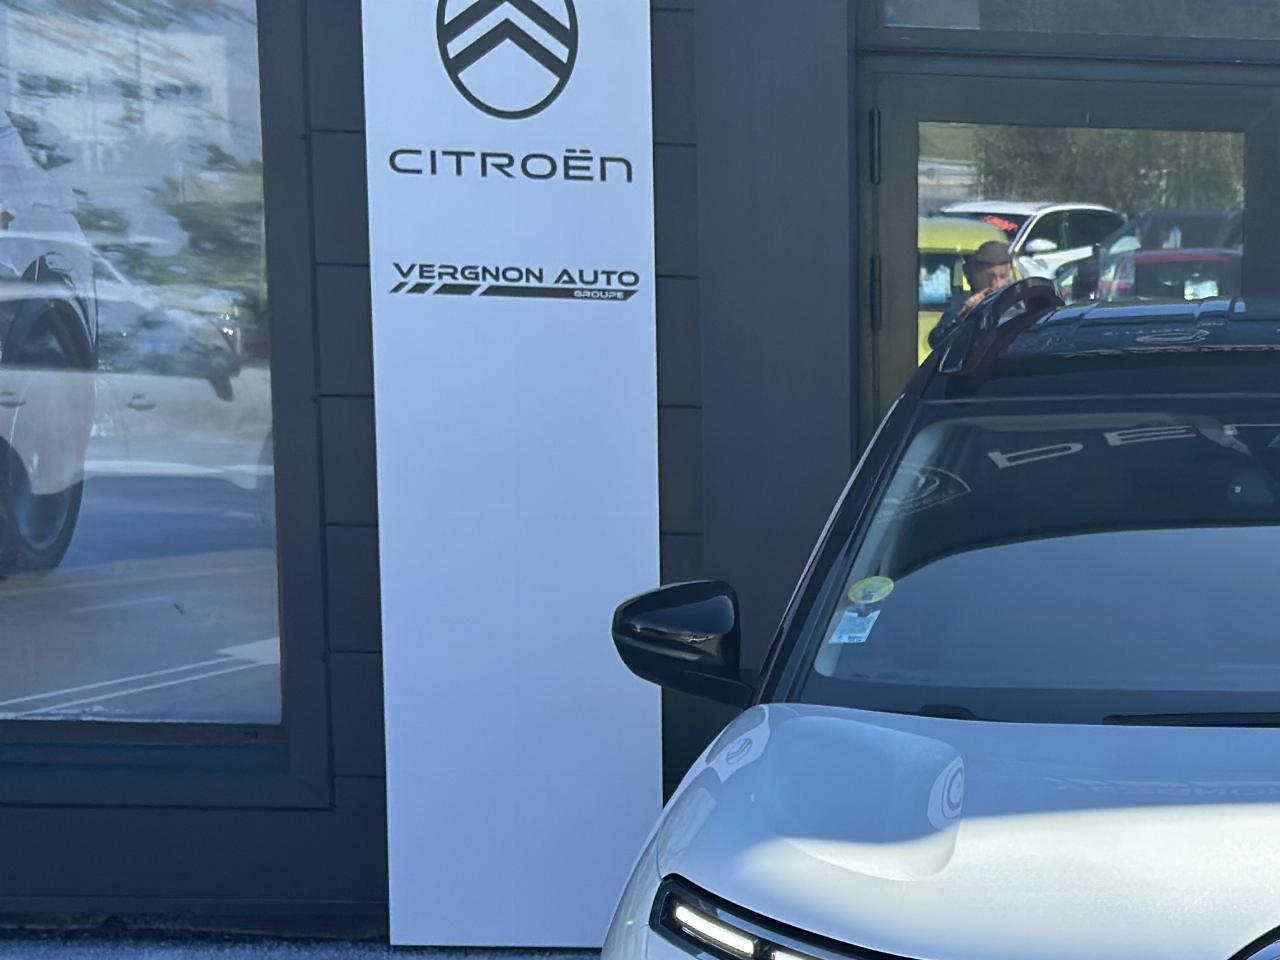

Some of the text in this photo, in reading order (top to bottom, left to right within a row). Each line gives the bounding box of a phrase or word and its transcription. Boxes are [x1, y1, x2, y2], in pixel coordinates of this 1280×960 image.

[388, 148, 633, 183] CITROËN
[392, 262, 640, 287] VERGNON AUTO
[574, 290, 624, 299] GROUPE
